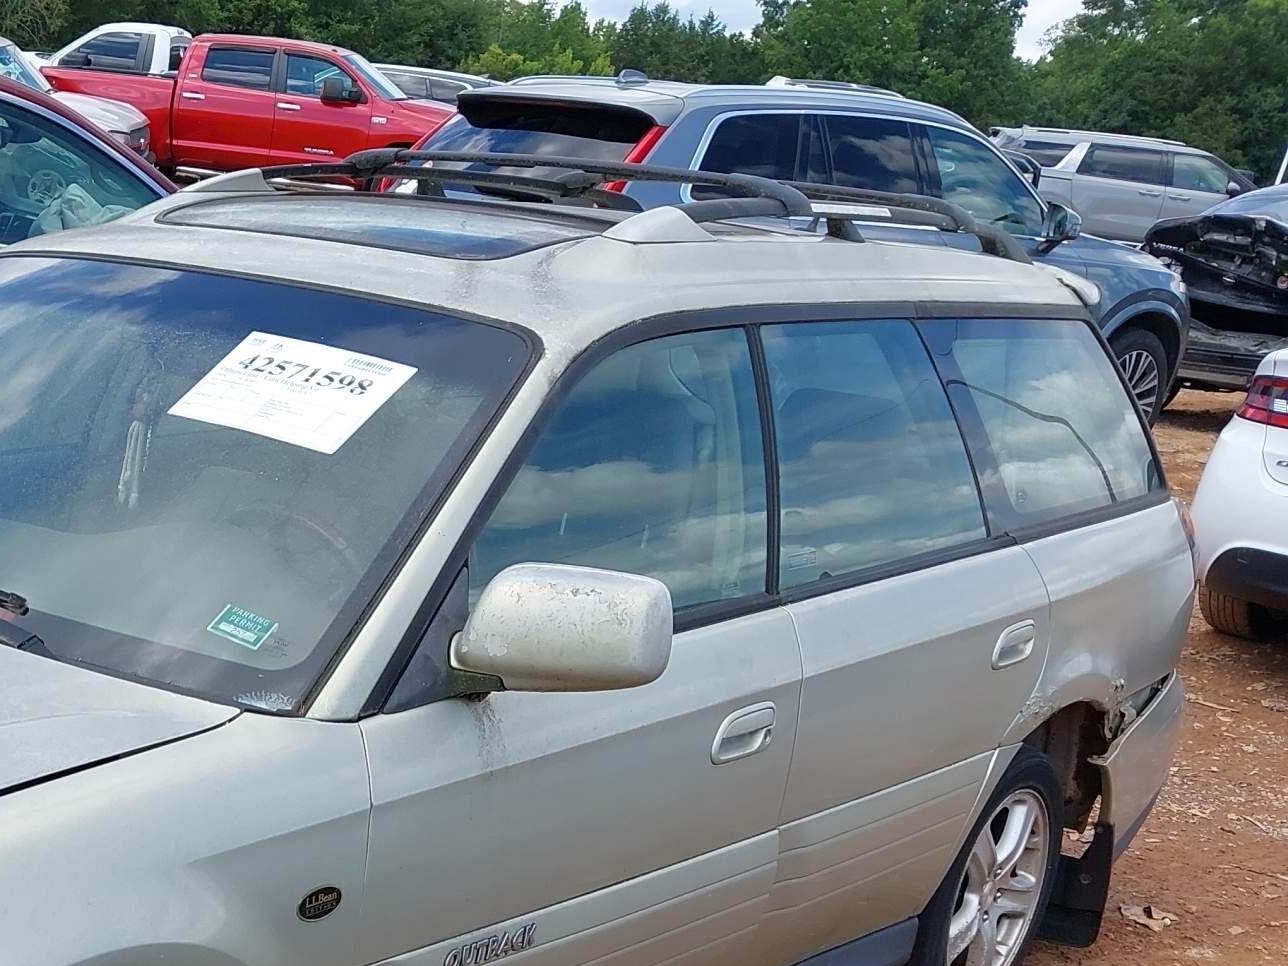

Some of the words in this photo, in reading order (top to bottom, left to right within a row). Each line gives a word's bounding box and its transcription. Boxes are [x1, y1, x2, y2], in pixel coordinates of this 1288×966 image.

[238, 354, 374, 396] 42571598
[229, 614, 263, 633] PERMIT
[231, 606, 271, 626] PARKING
